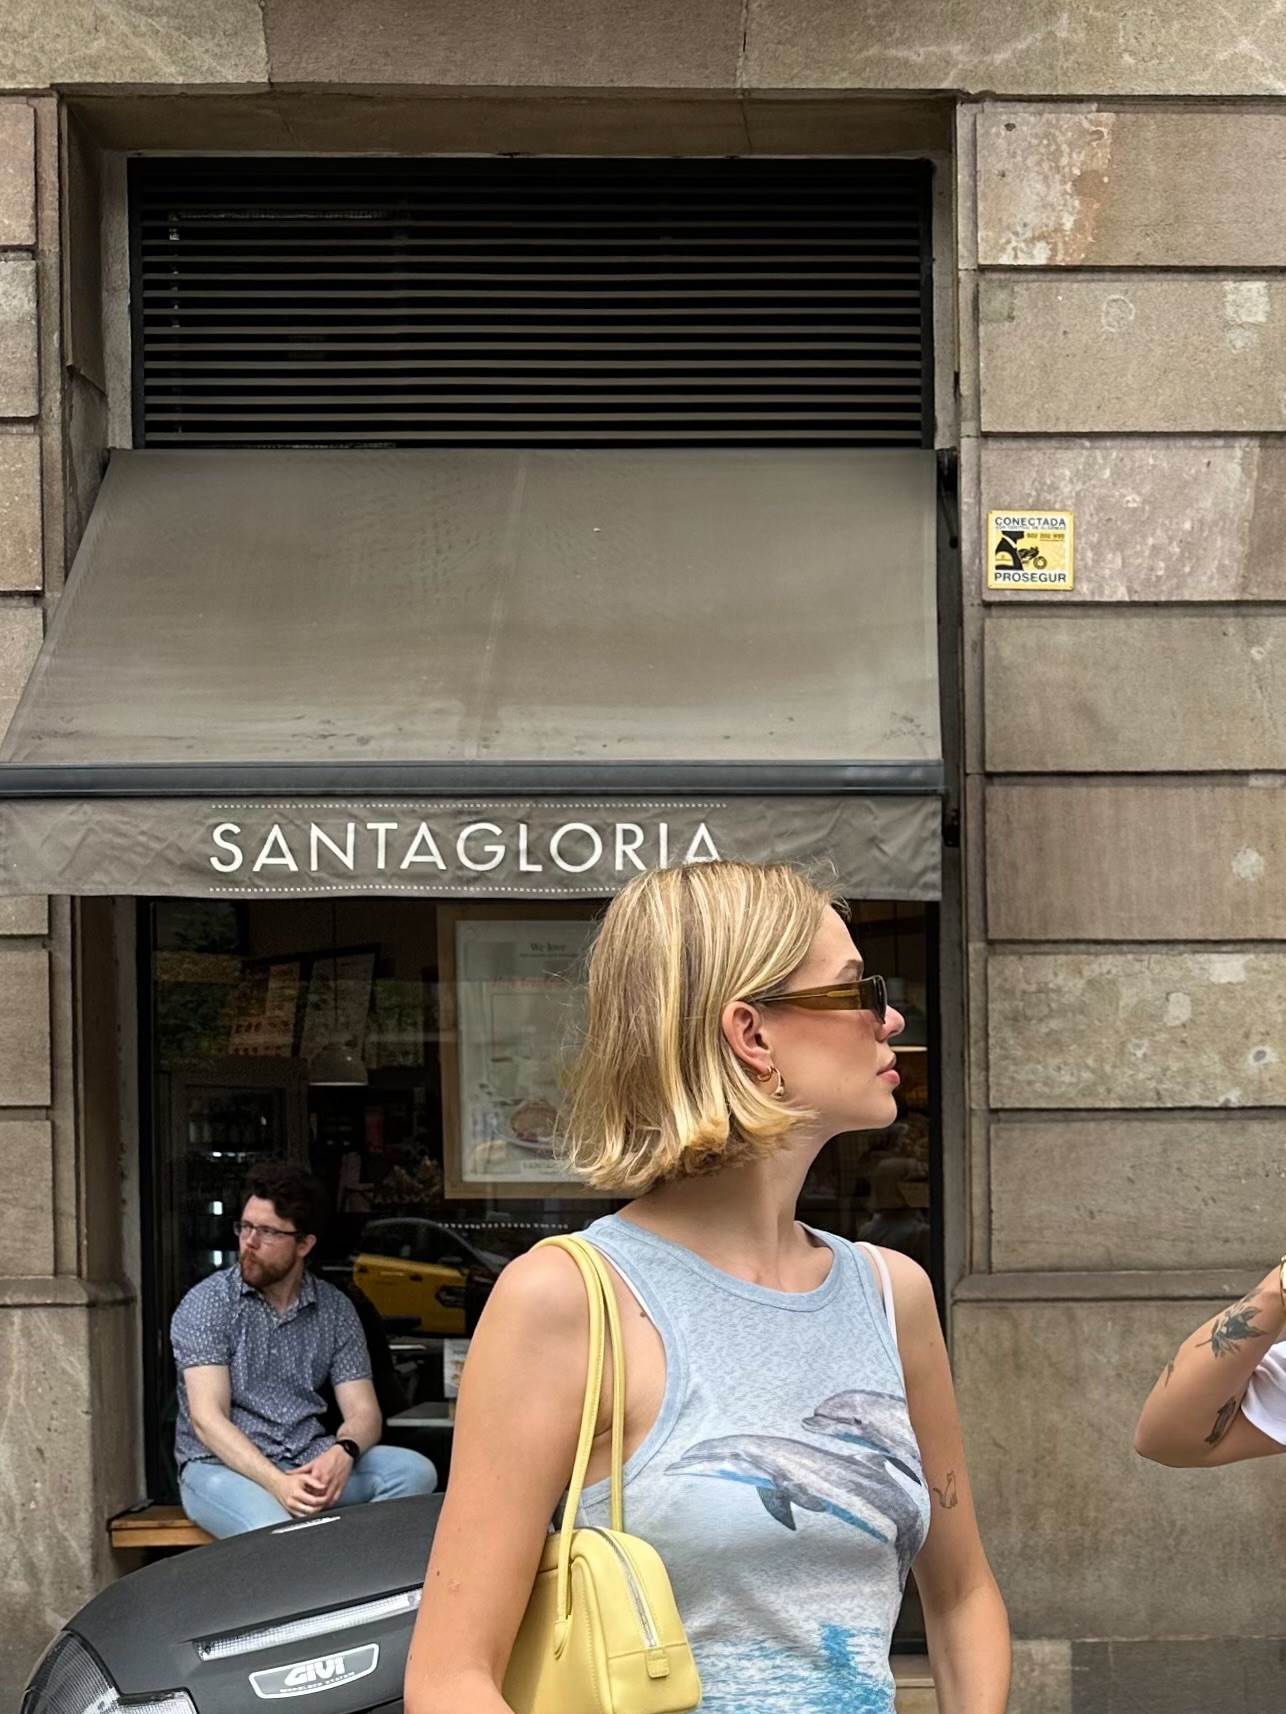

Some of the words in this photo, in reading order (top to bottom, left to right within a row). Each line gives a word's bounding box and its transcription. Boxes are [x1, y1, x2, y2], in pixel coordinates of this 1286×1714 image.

[994, 516, 1066, 527] CONECTADA
[994, 572, 1067, 583] PROSEGUR
[209, 822, 722, 873] SANTAGLORIA
[284, 1655, 347, 1686] GIVI
